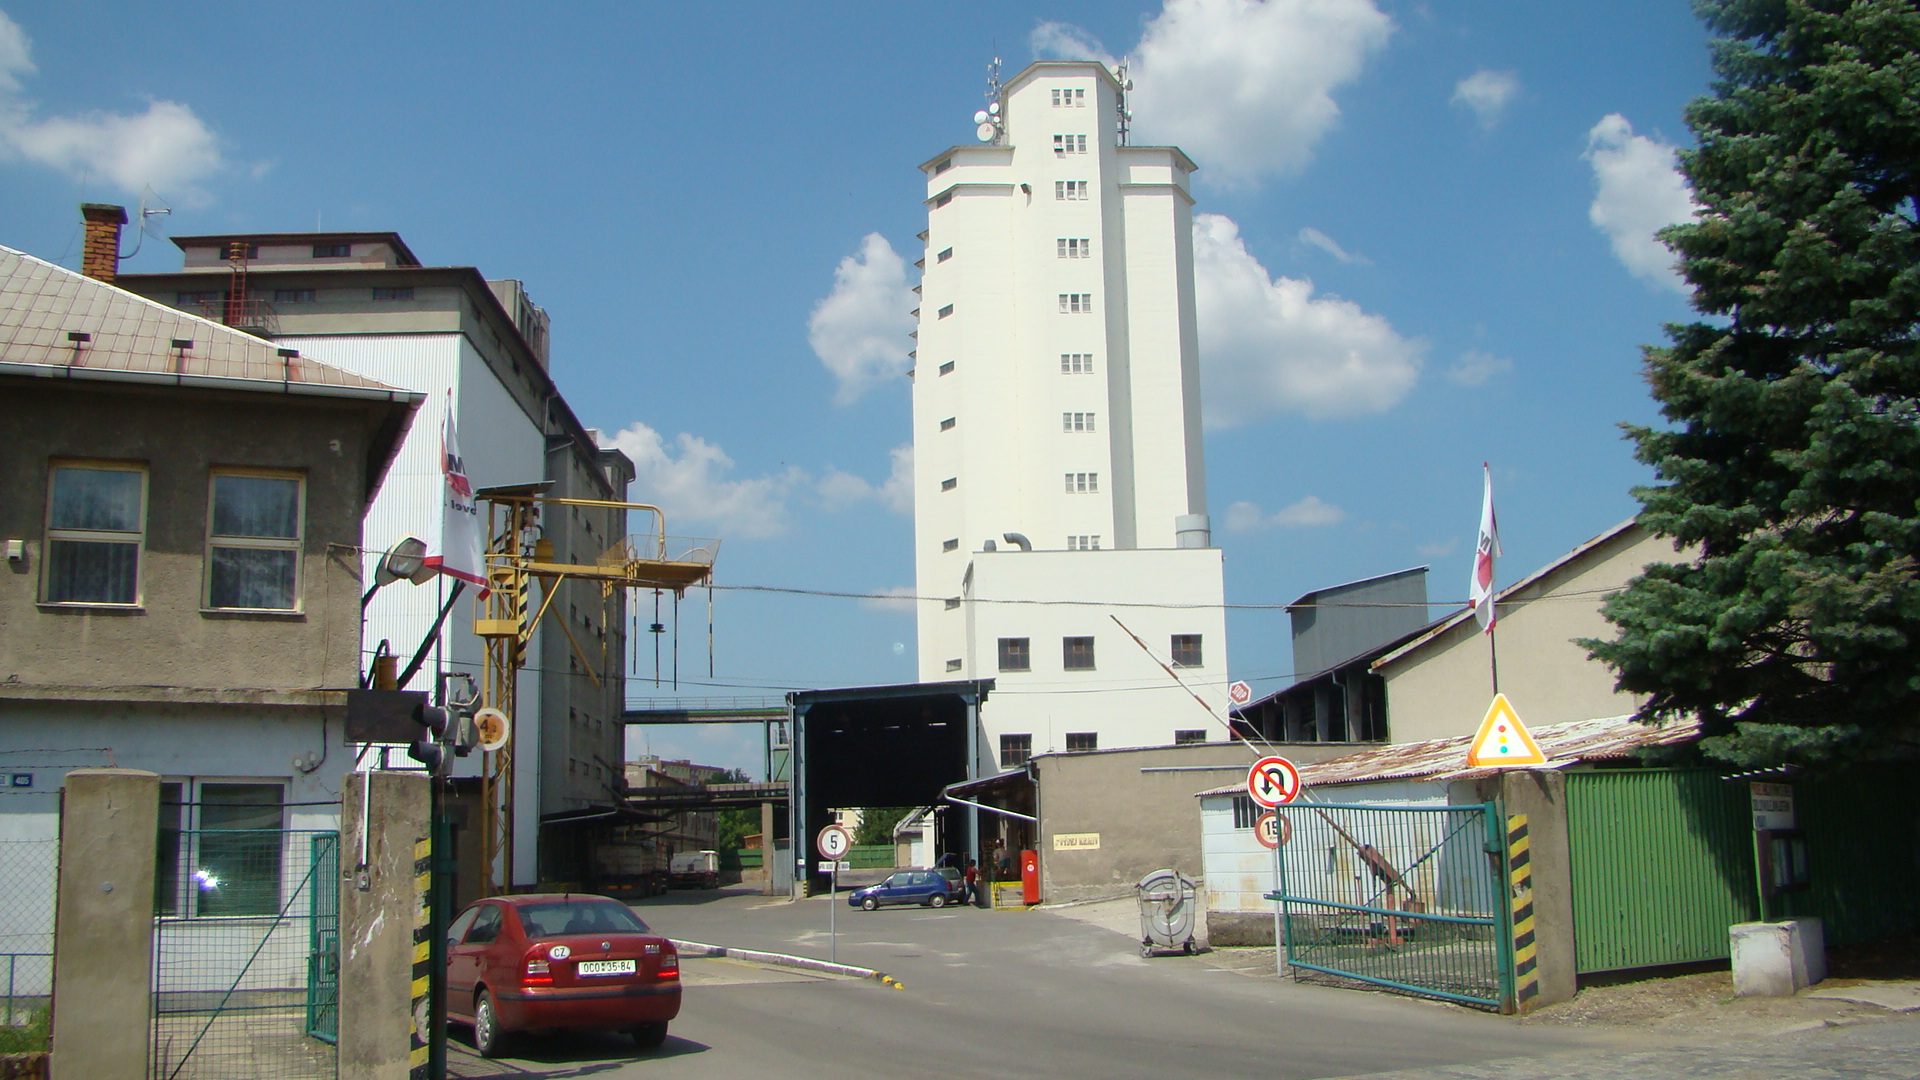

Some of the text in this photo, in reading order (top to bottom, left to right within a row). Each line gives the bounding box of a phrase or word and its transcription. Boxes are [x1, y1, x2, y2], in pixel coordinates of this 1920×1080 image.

[1232, 685, 1247, 700] STOP
[1265, 821, 1278, 836] 15
[830, 834, 838, 850] 5
[554, 947, 566, 958] CZ
[606, 961, 631, 972] 35-84
